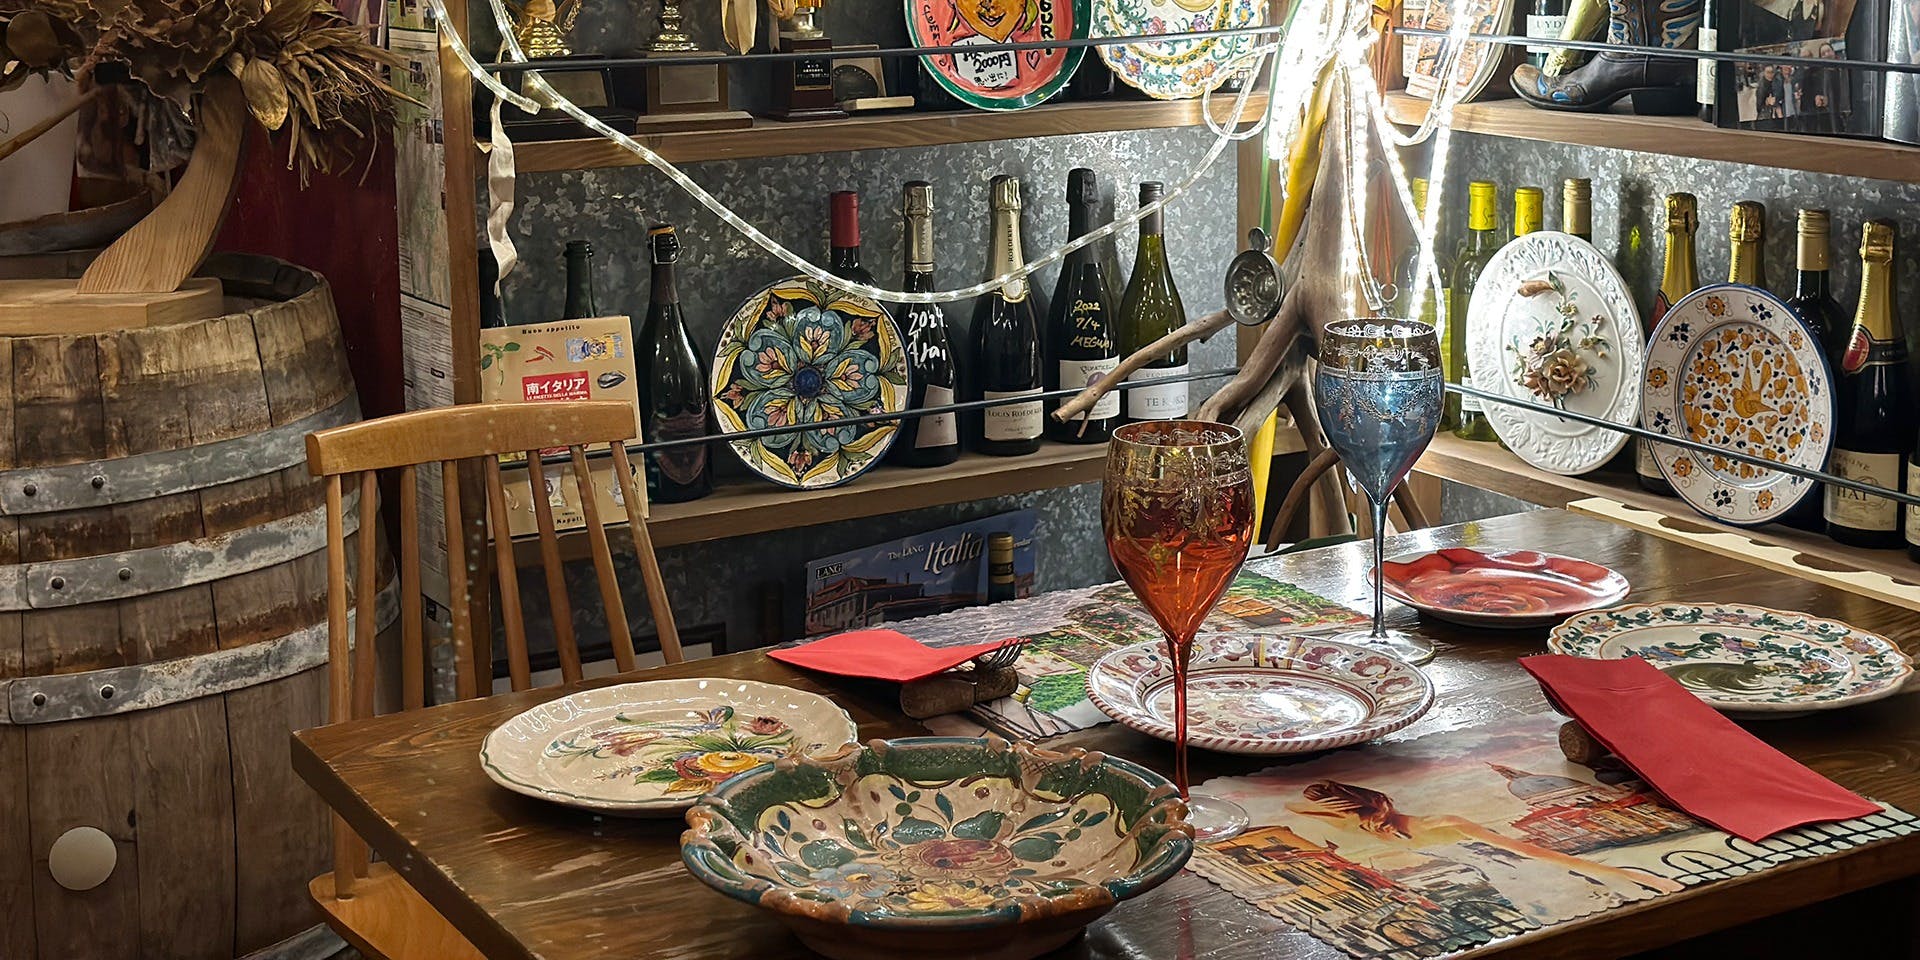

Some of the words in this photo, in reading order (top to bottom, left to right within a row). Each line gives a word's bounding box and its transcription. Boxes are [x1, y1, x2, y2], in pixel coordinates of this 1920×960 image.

[973, 52, 1012, 73] 2000円
[1073, 299, 1101, 314] 2022
[1075, 316, 1101, 331] 7/4
[525, 378, 586, 395] 南イタリア
[987, 410, 1010, 418] LOUIS
[888, 551, 902, 561] The
[901, 545, 924, 557] LANG
[923, 532, 983, 575] Italia
[816, 563, 842, 579] LANG
